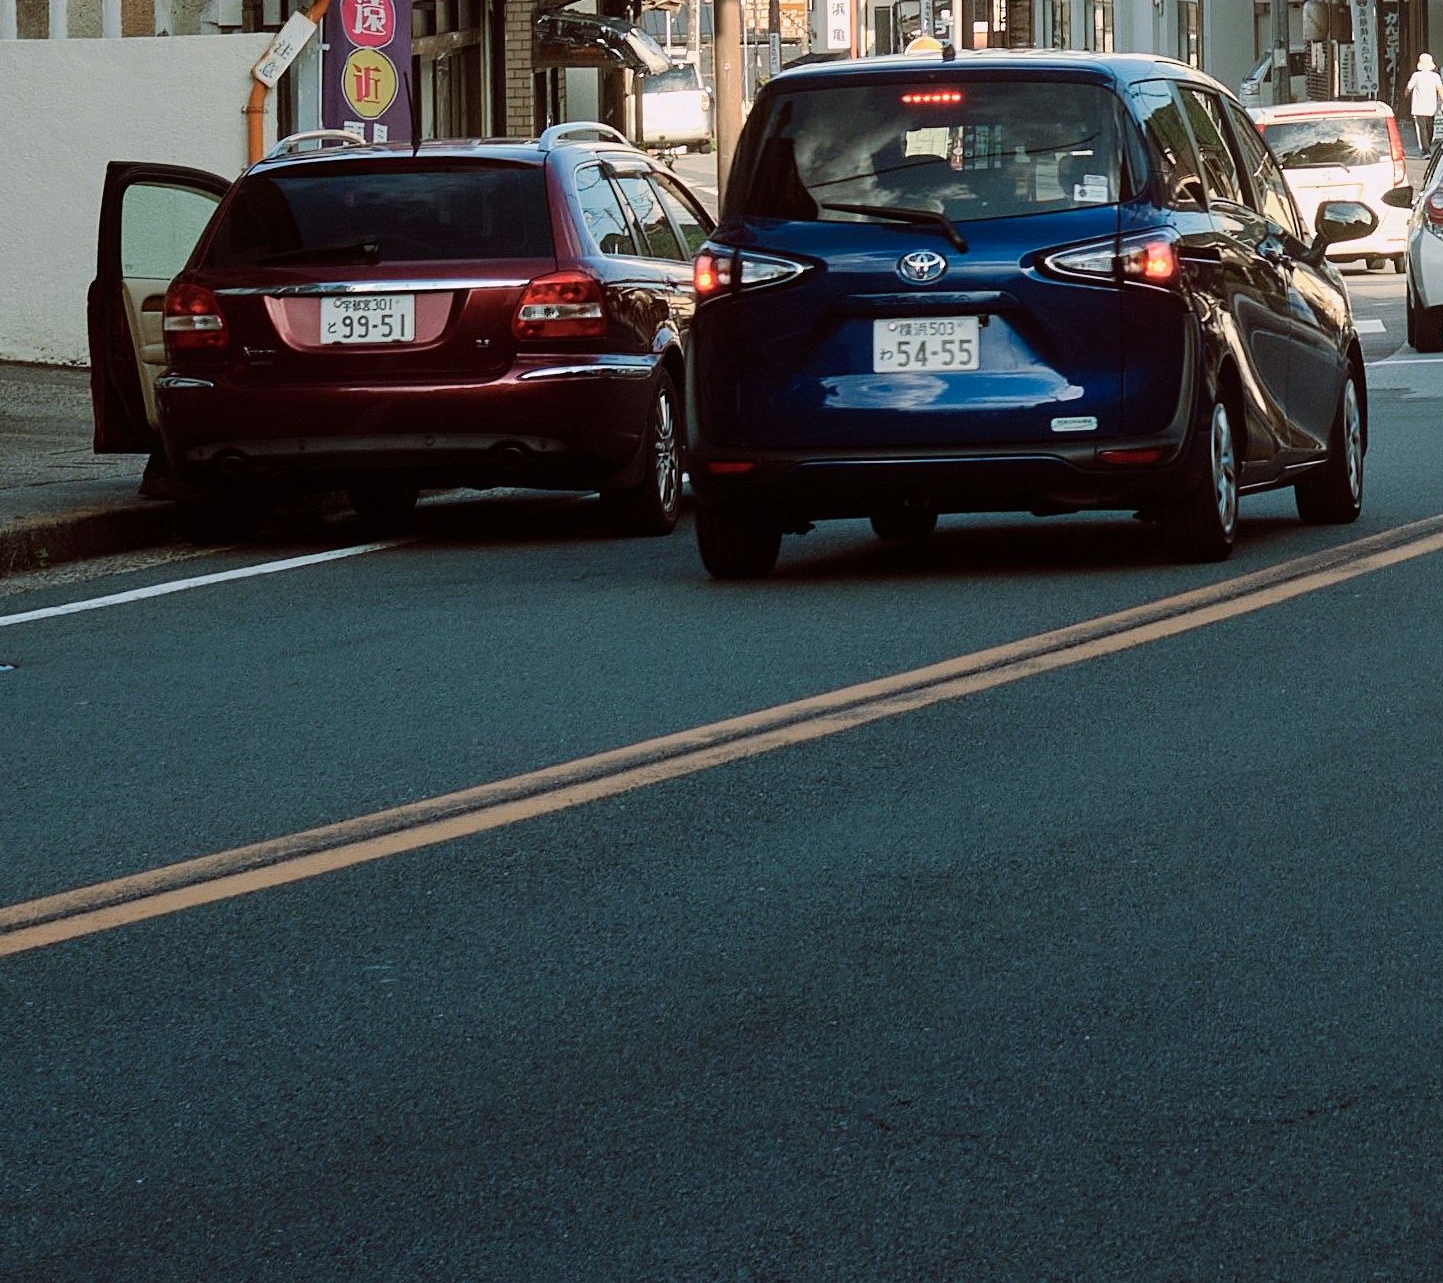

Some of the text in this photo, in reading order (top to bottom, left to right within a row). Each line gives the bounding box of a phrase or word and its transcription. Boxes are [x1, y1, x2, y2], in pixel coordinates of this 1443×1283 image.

[341, 313, 406, 339] 99-51
[879, 338, 974, 367] わ 54-55
